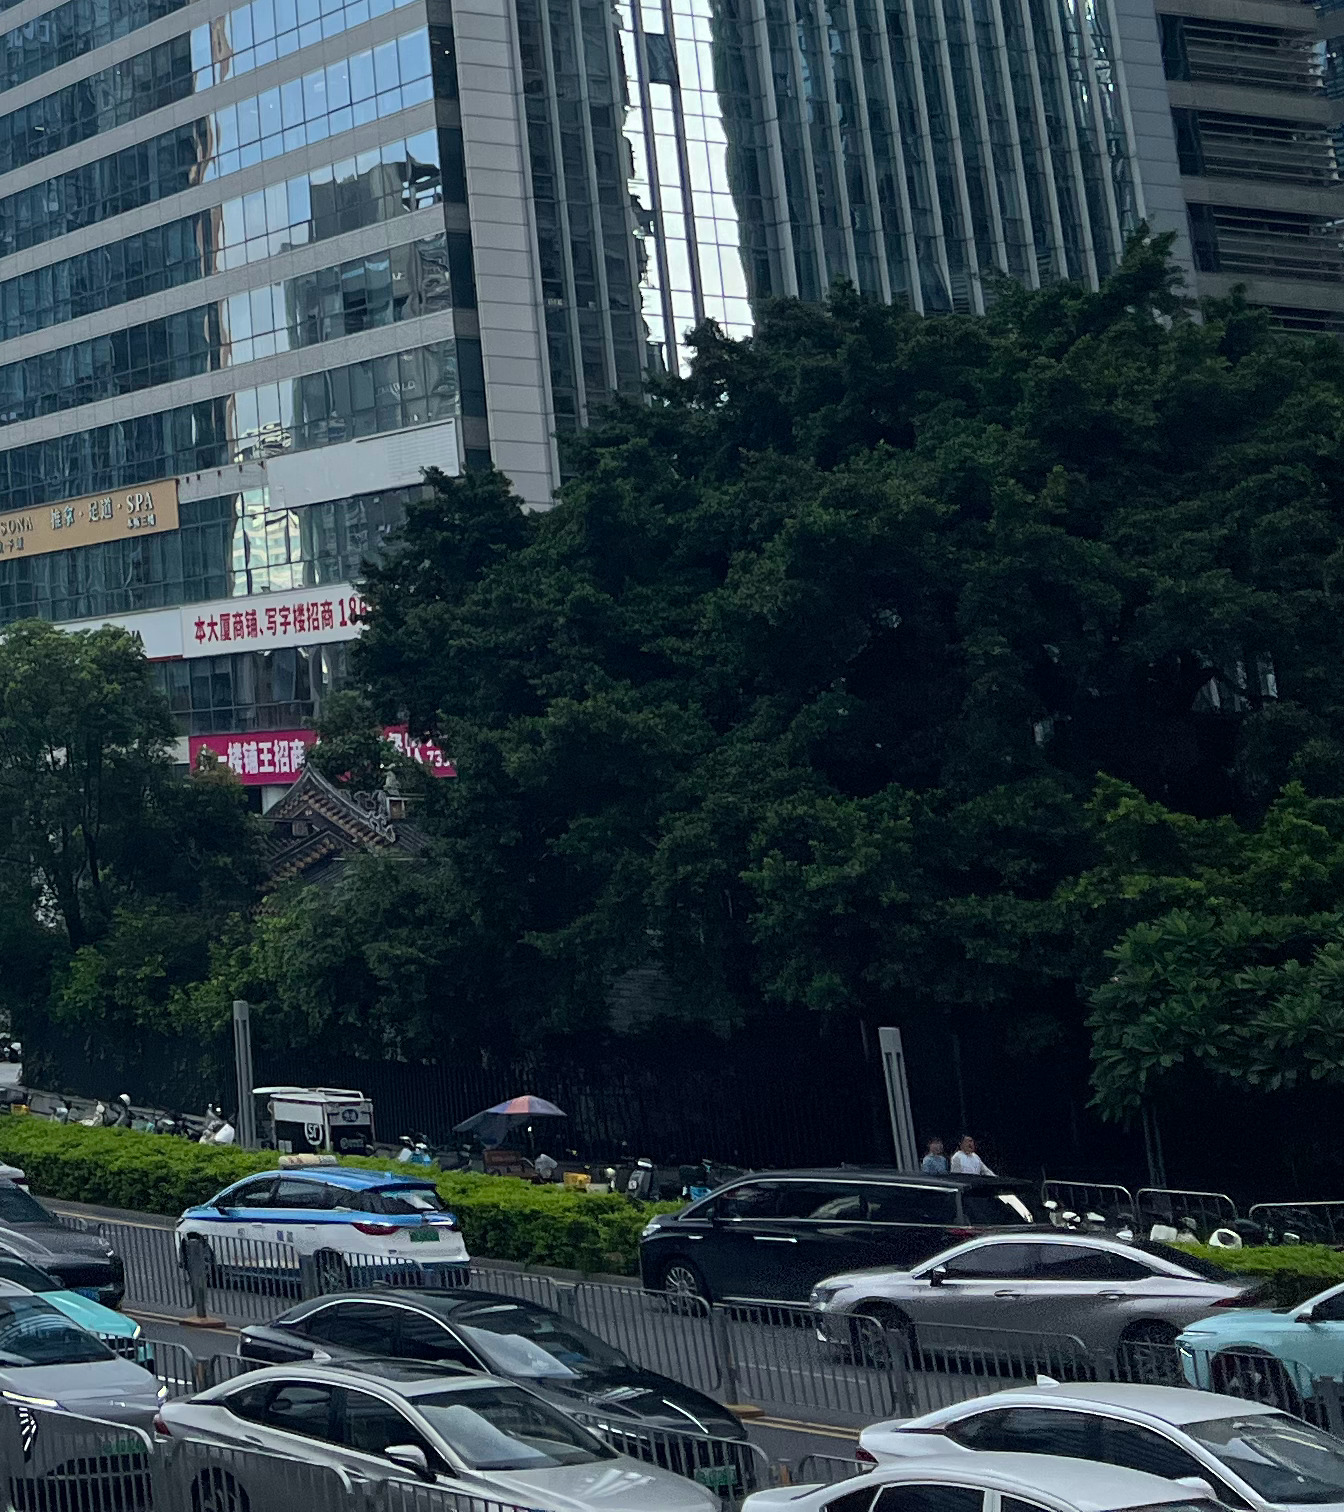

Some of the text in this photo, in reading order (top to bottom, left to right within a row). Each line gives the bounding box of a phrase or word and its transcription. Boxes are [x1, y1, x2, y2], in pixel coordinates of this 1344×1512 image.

[194, 599, 335, 645] 本大厦商铺、写字楼招商
